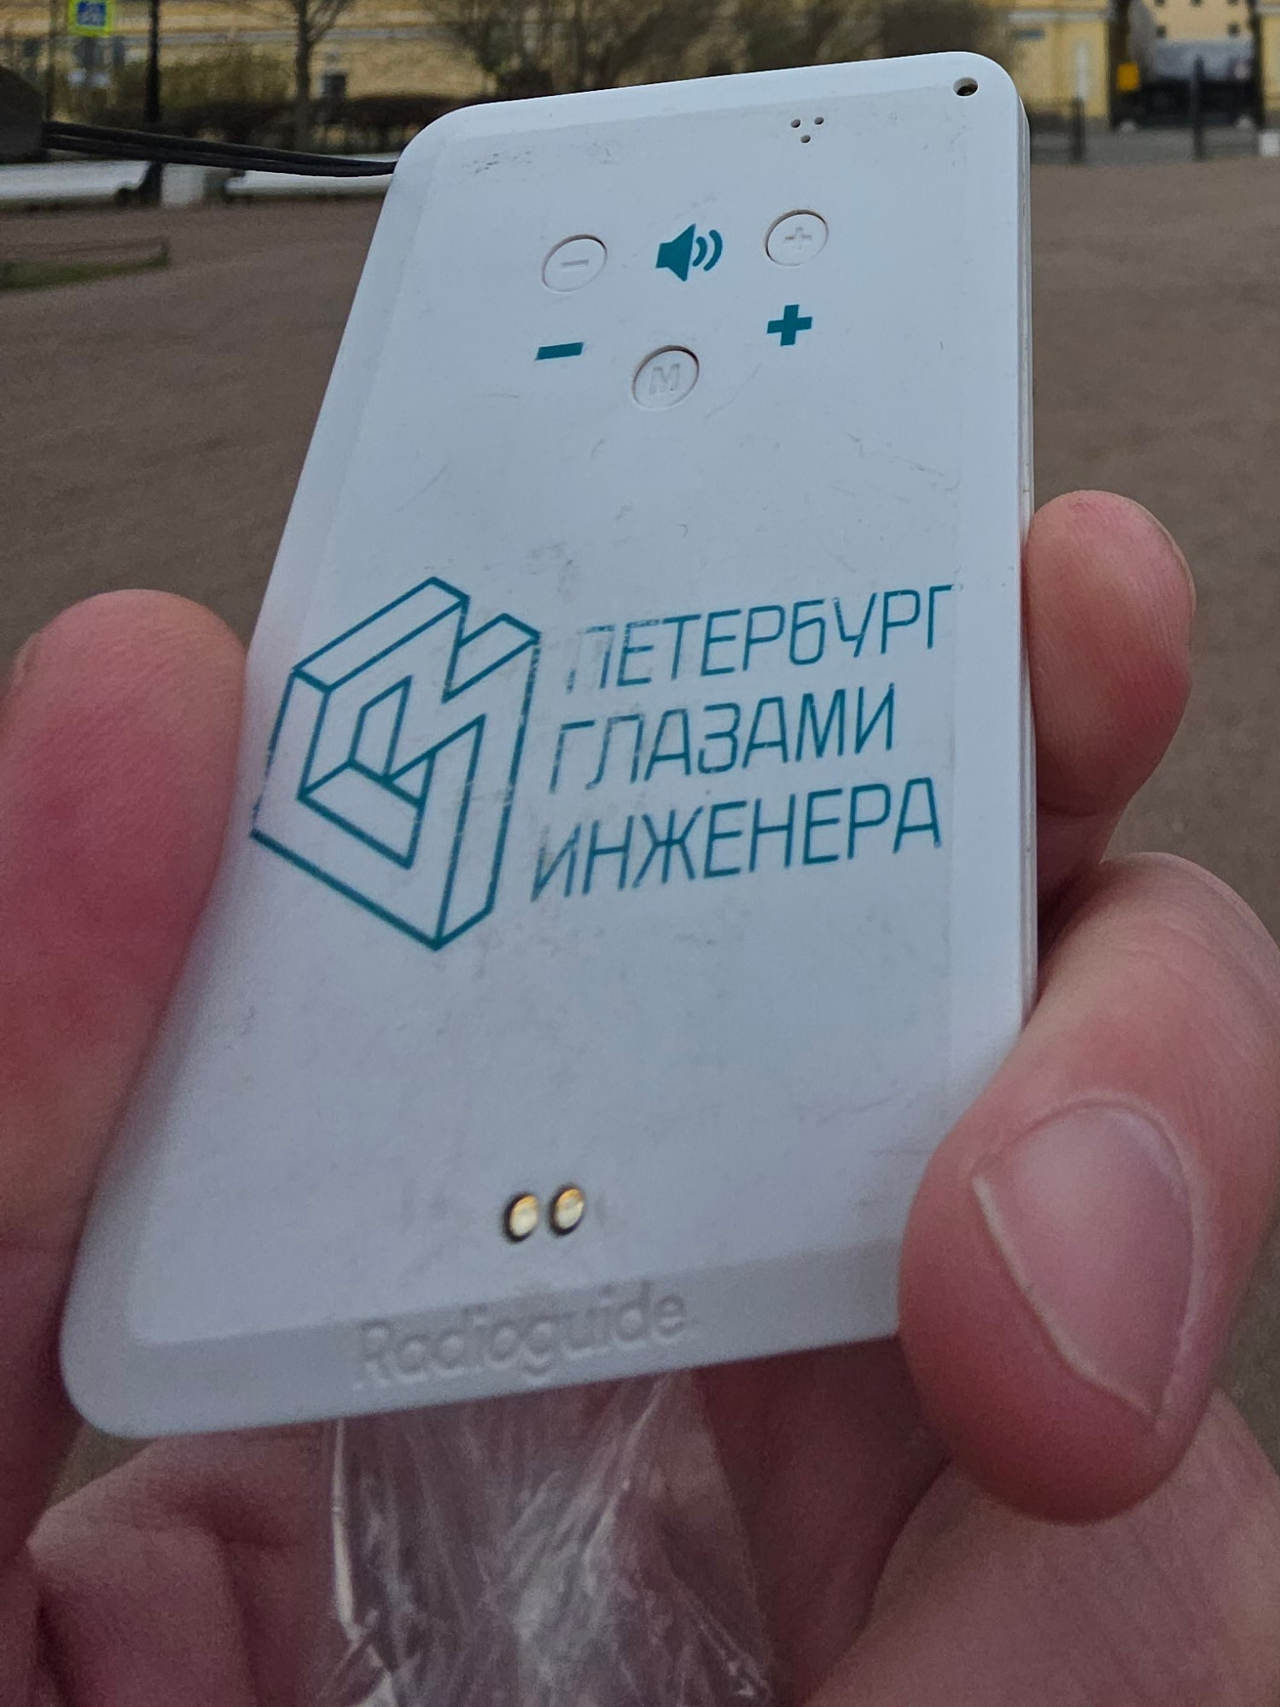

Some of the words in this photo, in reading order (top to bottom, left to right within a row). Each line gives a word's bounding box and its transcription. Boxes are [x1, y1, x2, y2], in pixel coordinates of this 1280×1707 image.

[565, 583, 955, 694] ПЕТЕРБУРГ
[550, 683, 896, 793] ГЛАЗАМИ
[531, 776, 941, 902] ИНЖЕНЕРА
[356, 1279, 687, 1384] Radioguide
